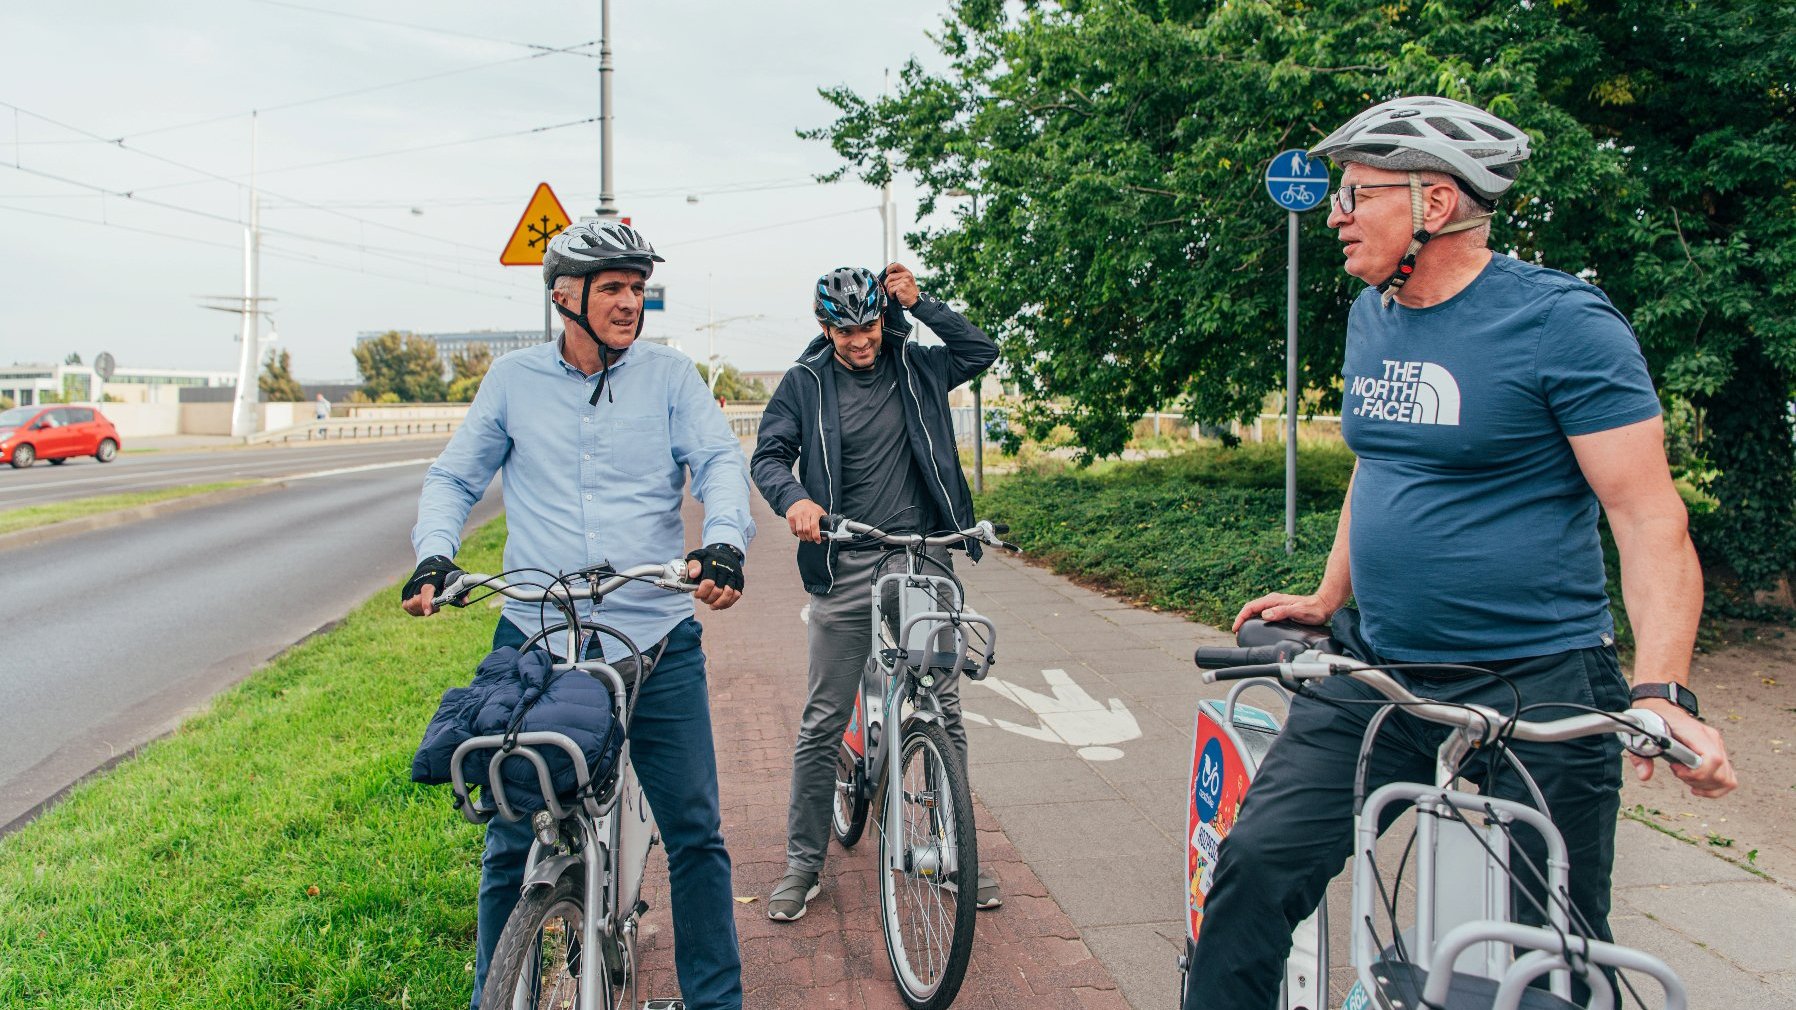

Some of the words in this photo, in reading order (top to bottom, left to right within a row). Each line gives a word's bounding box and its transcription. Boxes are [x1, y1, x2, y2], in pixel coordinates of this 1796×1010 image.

[1382, 360, 1422, 382] THE
[1350, 375, 1418, 403] NORTH
[1360, 397, 1413, 423] FACE
